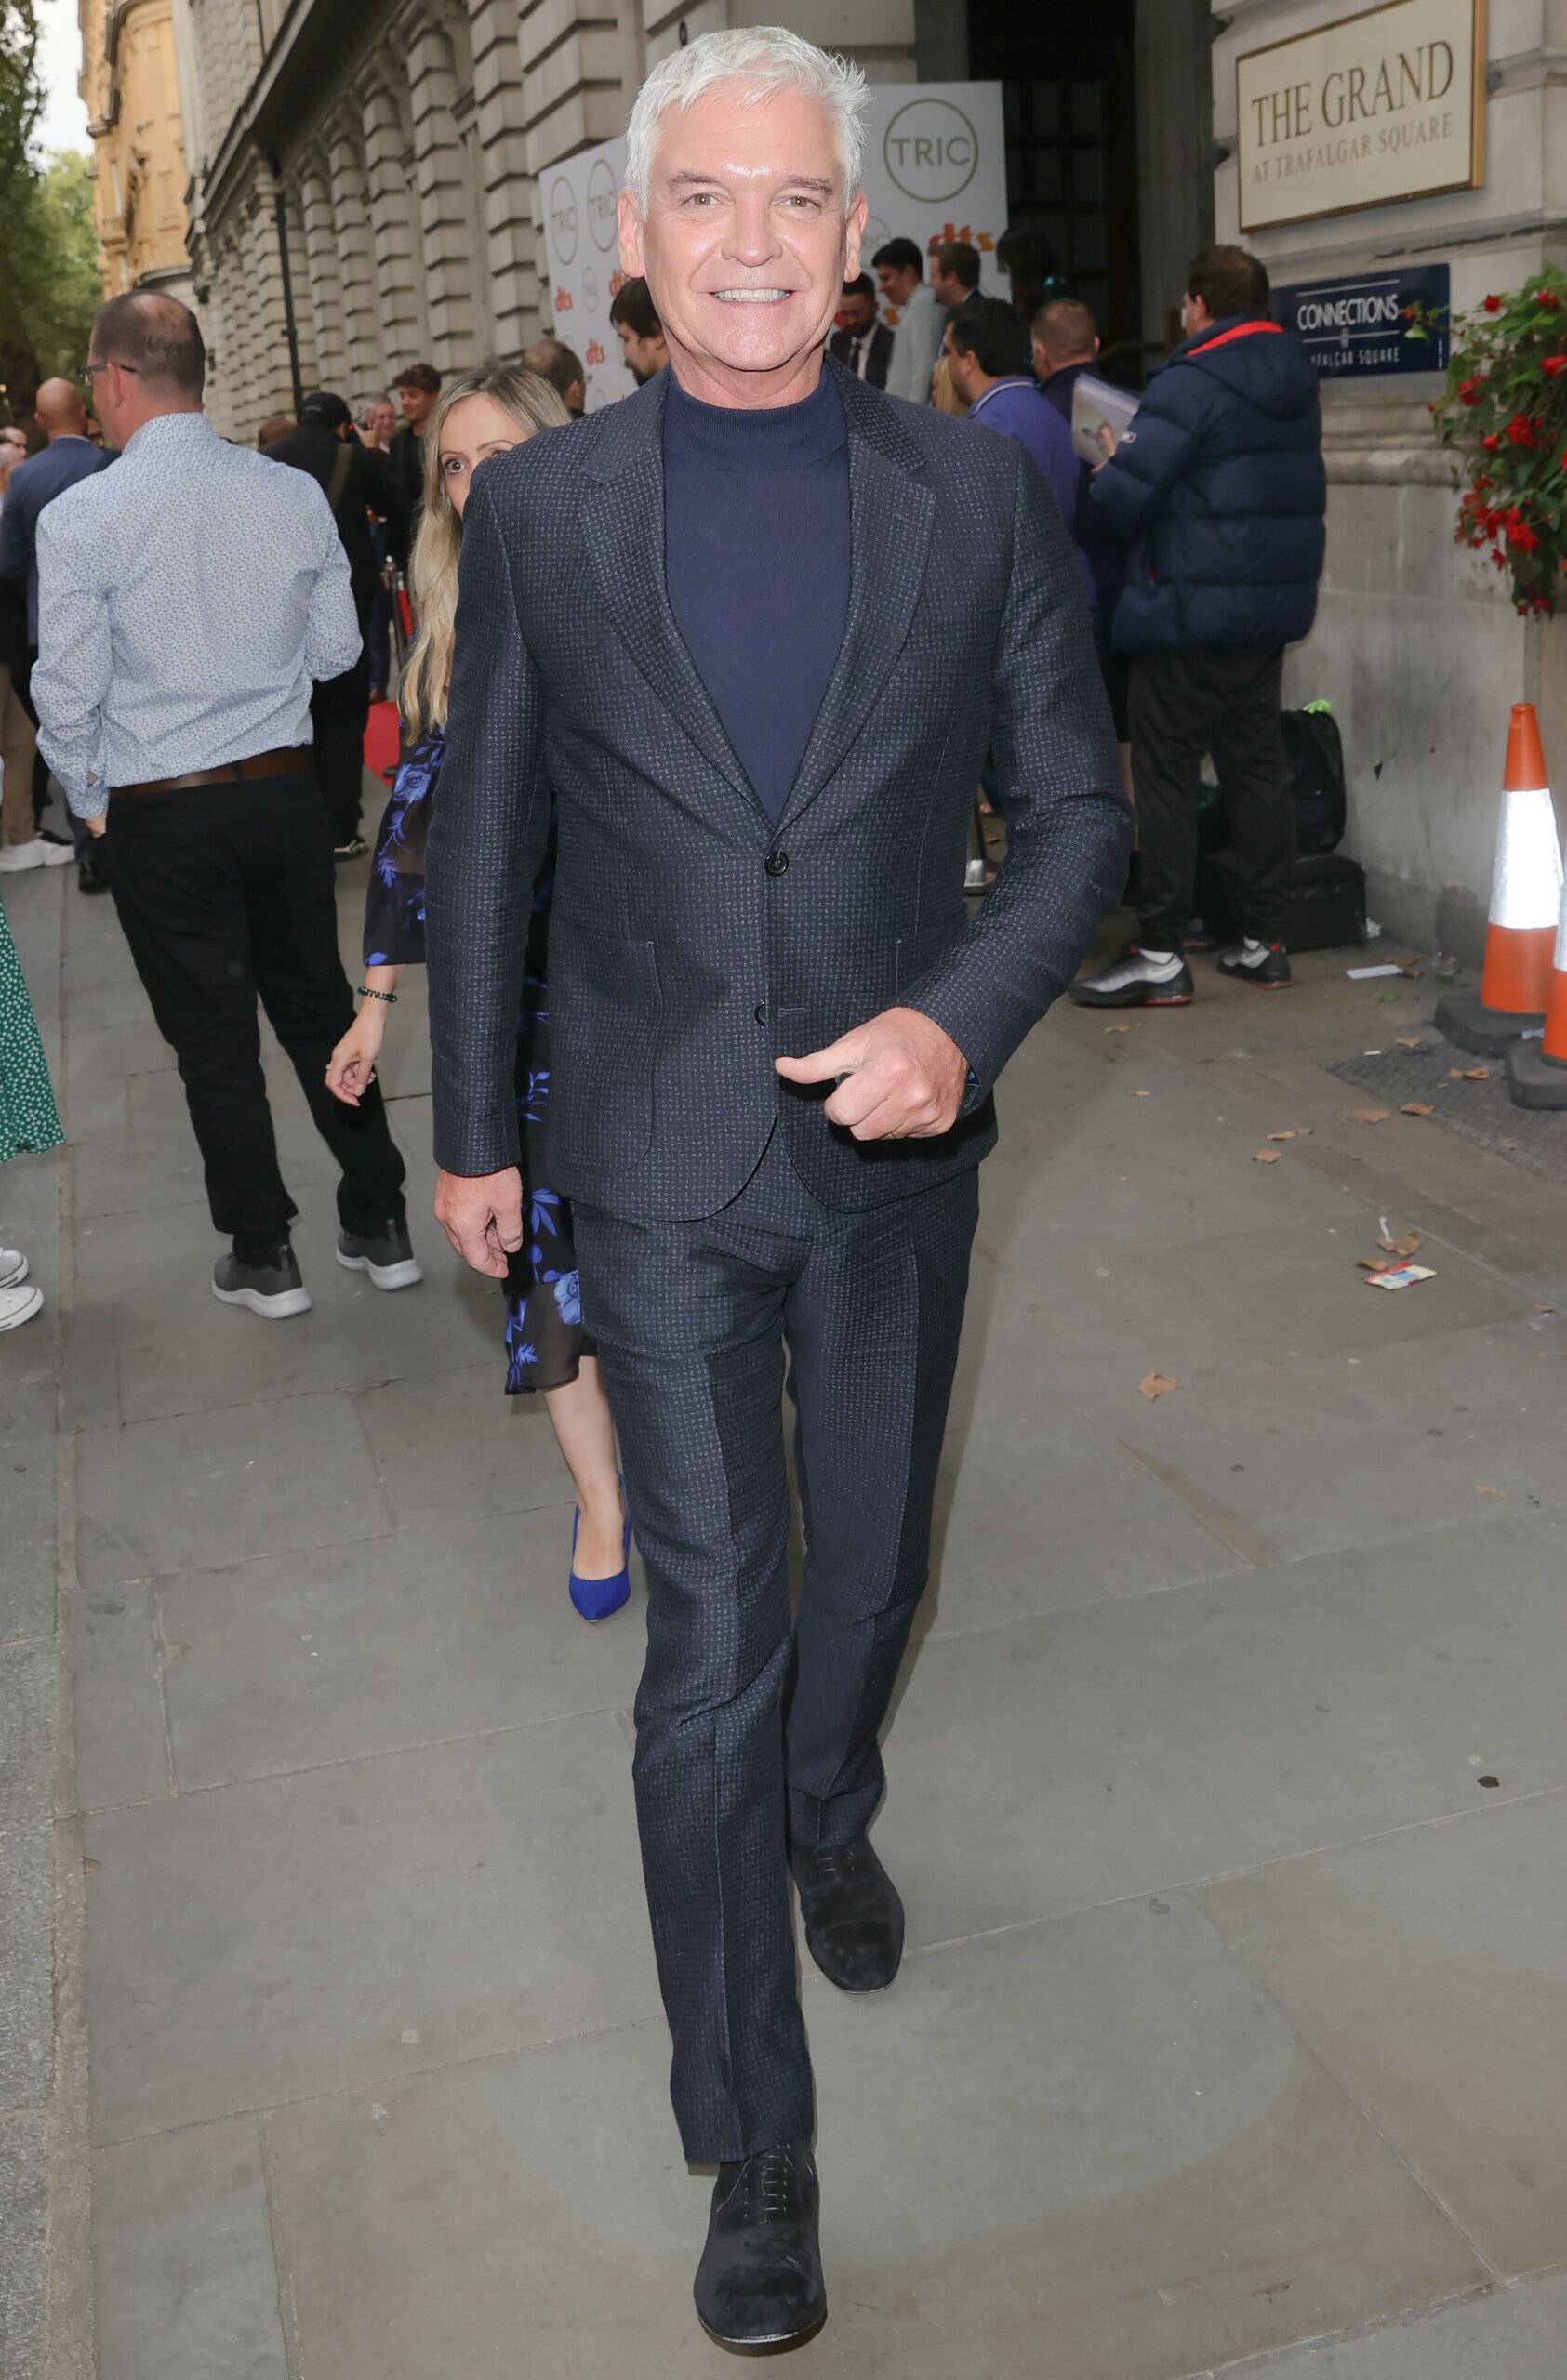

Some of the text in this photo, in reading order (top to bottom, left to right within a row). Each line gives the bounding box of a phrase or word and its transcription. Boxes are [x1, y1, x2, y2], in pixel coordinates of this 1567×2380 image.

[1251, 41, 1454, 149] THE GRAND
[891, 137, 971, 167] TRIC
[1253, 112, 1454, 184] AT TRAFALGAR SQUARE
[1297, 293, 1400, 331] CONNECTIONS
[1358, 346, 1400, 365] SQUARE
